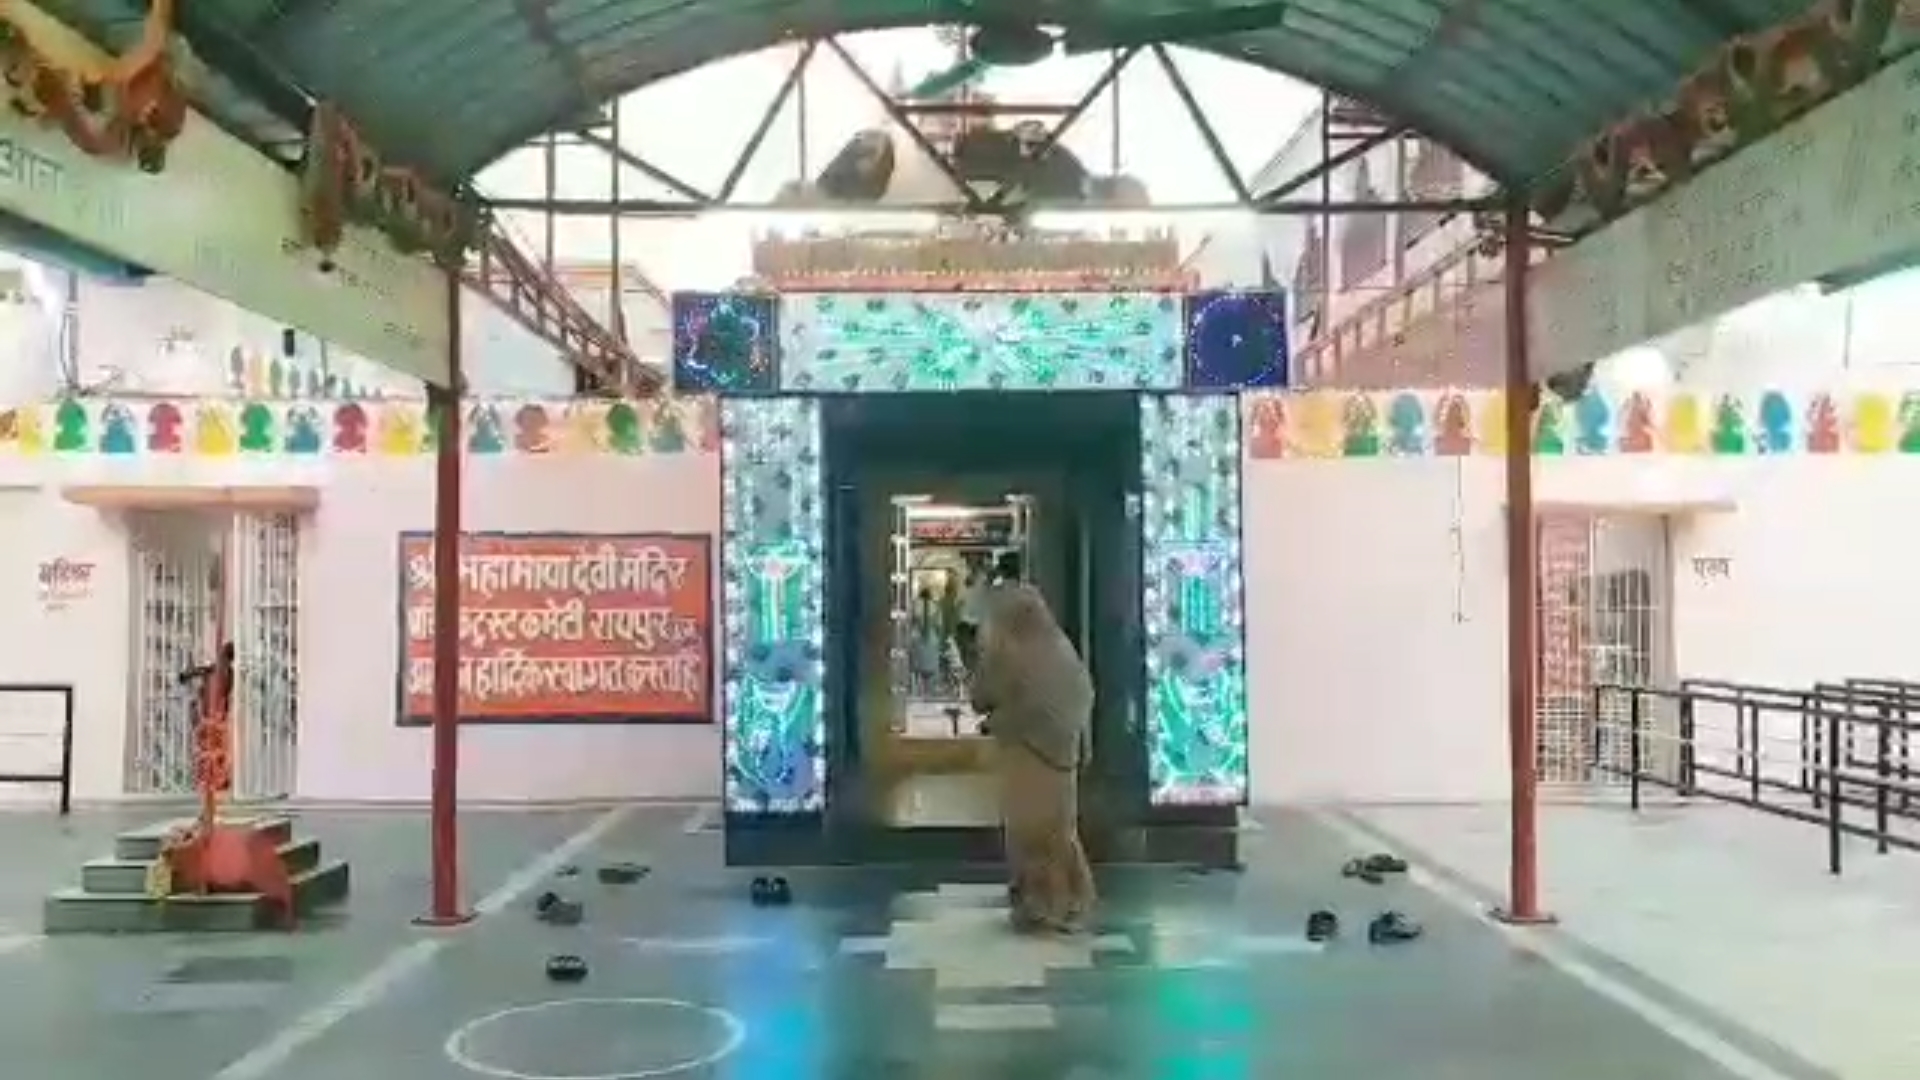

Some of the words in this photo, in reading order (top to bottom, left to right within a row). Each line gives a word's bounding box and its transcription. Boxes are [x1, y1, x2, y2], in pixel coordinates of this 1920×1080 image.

[572, 542, 617, 596] देवी
[518, 597, 583, 641] कमेटी
[589, 607, 673, 651] रायपुर
[540, 656, 623, 694] स्वागत
